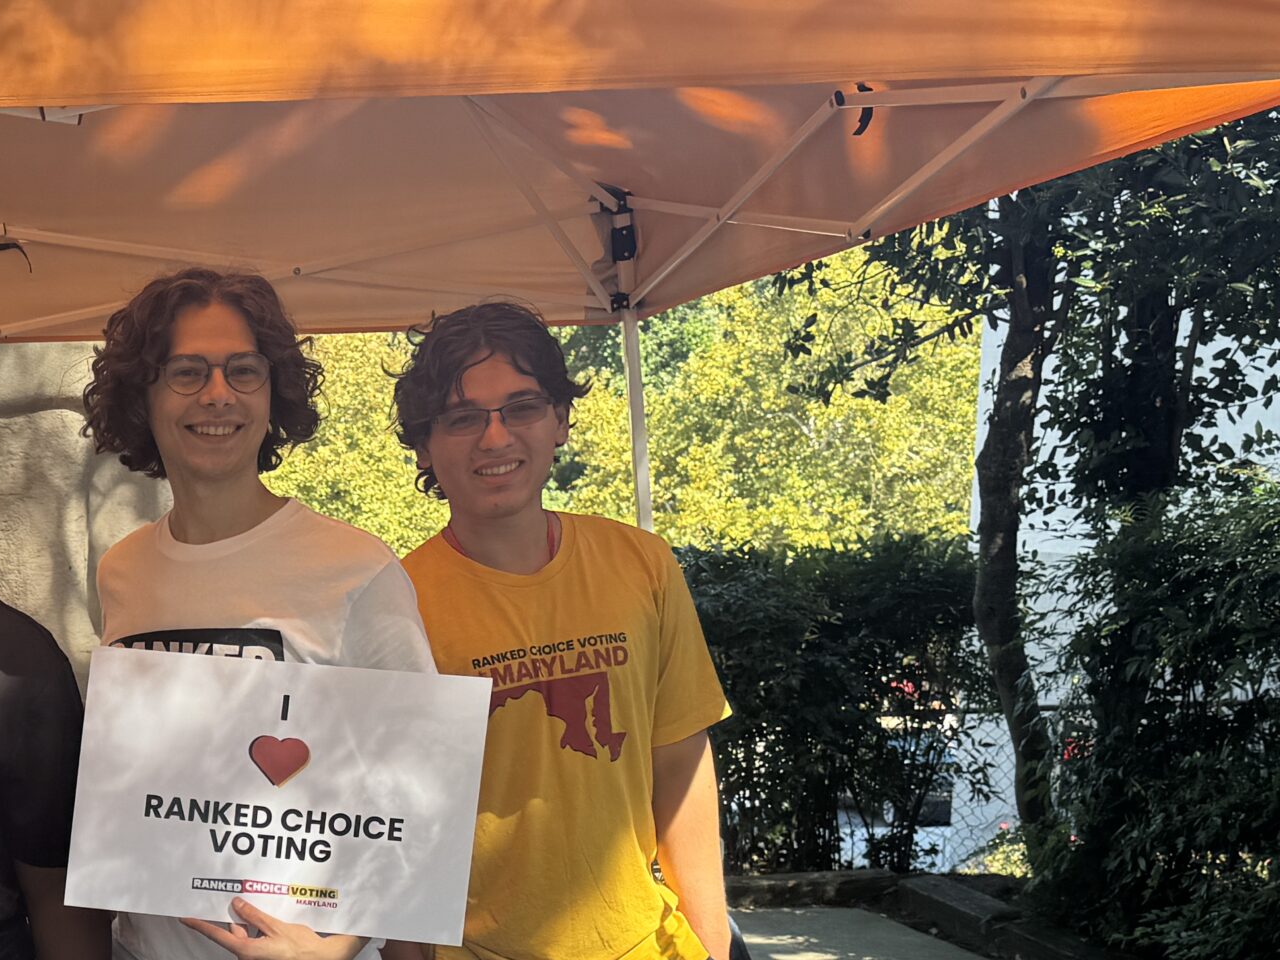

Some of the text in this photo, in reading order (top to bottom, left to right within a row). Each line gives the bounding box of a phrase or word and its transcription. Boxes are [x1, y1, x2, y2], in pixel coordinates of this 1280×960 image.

[472, 632, 627, 670] RANKED CHOICE VOTING
[489, 645, 629, 687] MARYLAND
[280, 694, 290, 721] I
[144, 793, 405, 842] RANKED CHOICE
[209, 829, 332, 863] VOTING
[193, 879, 336, 899] RANKED CHOICE VOTING
[296, 898, 338, 909] MARYLAND
